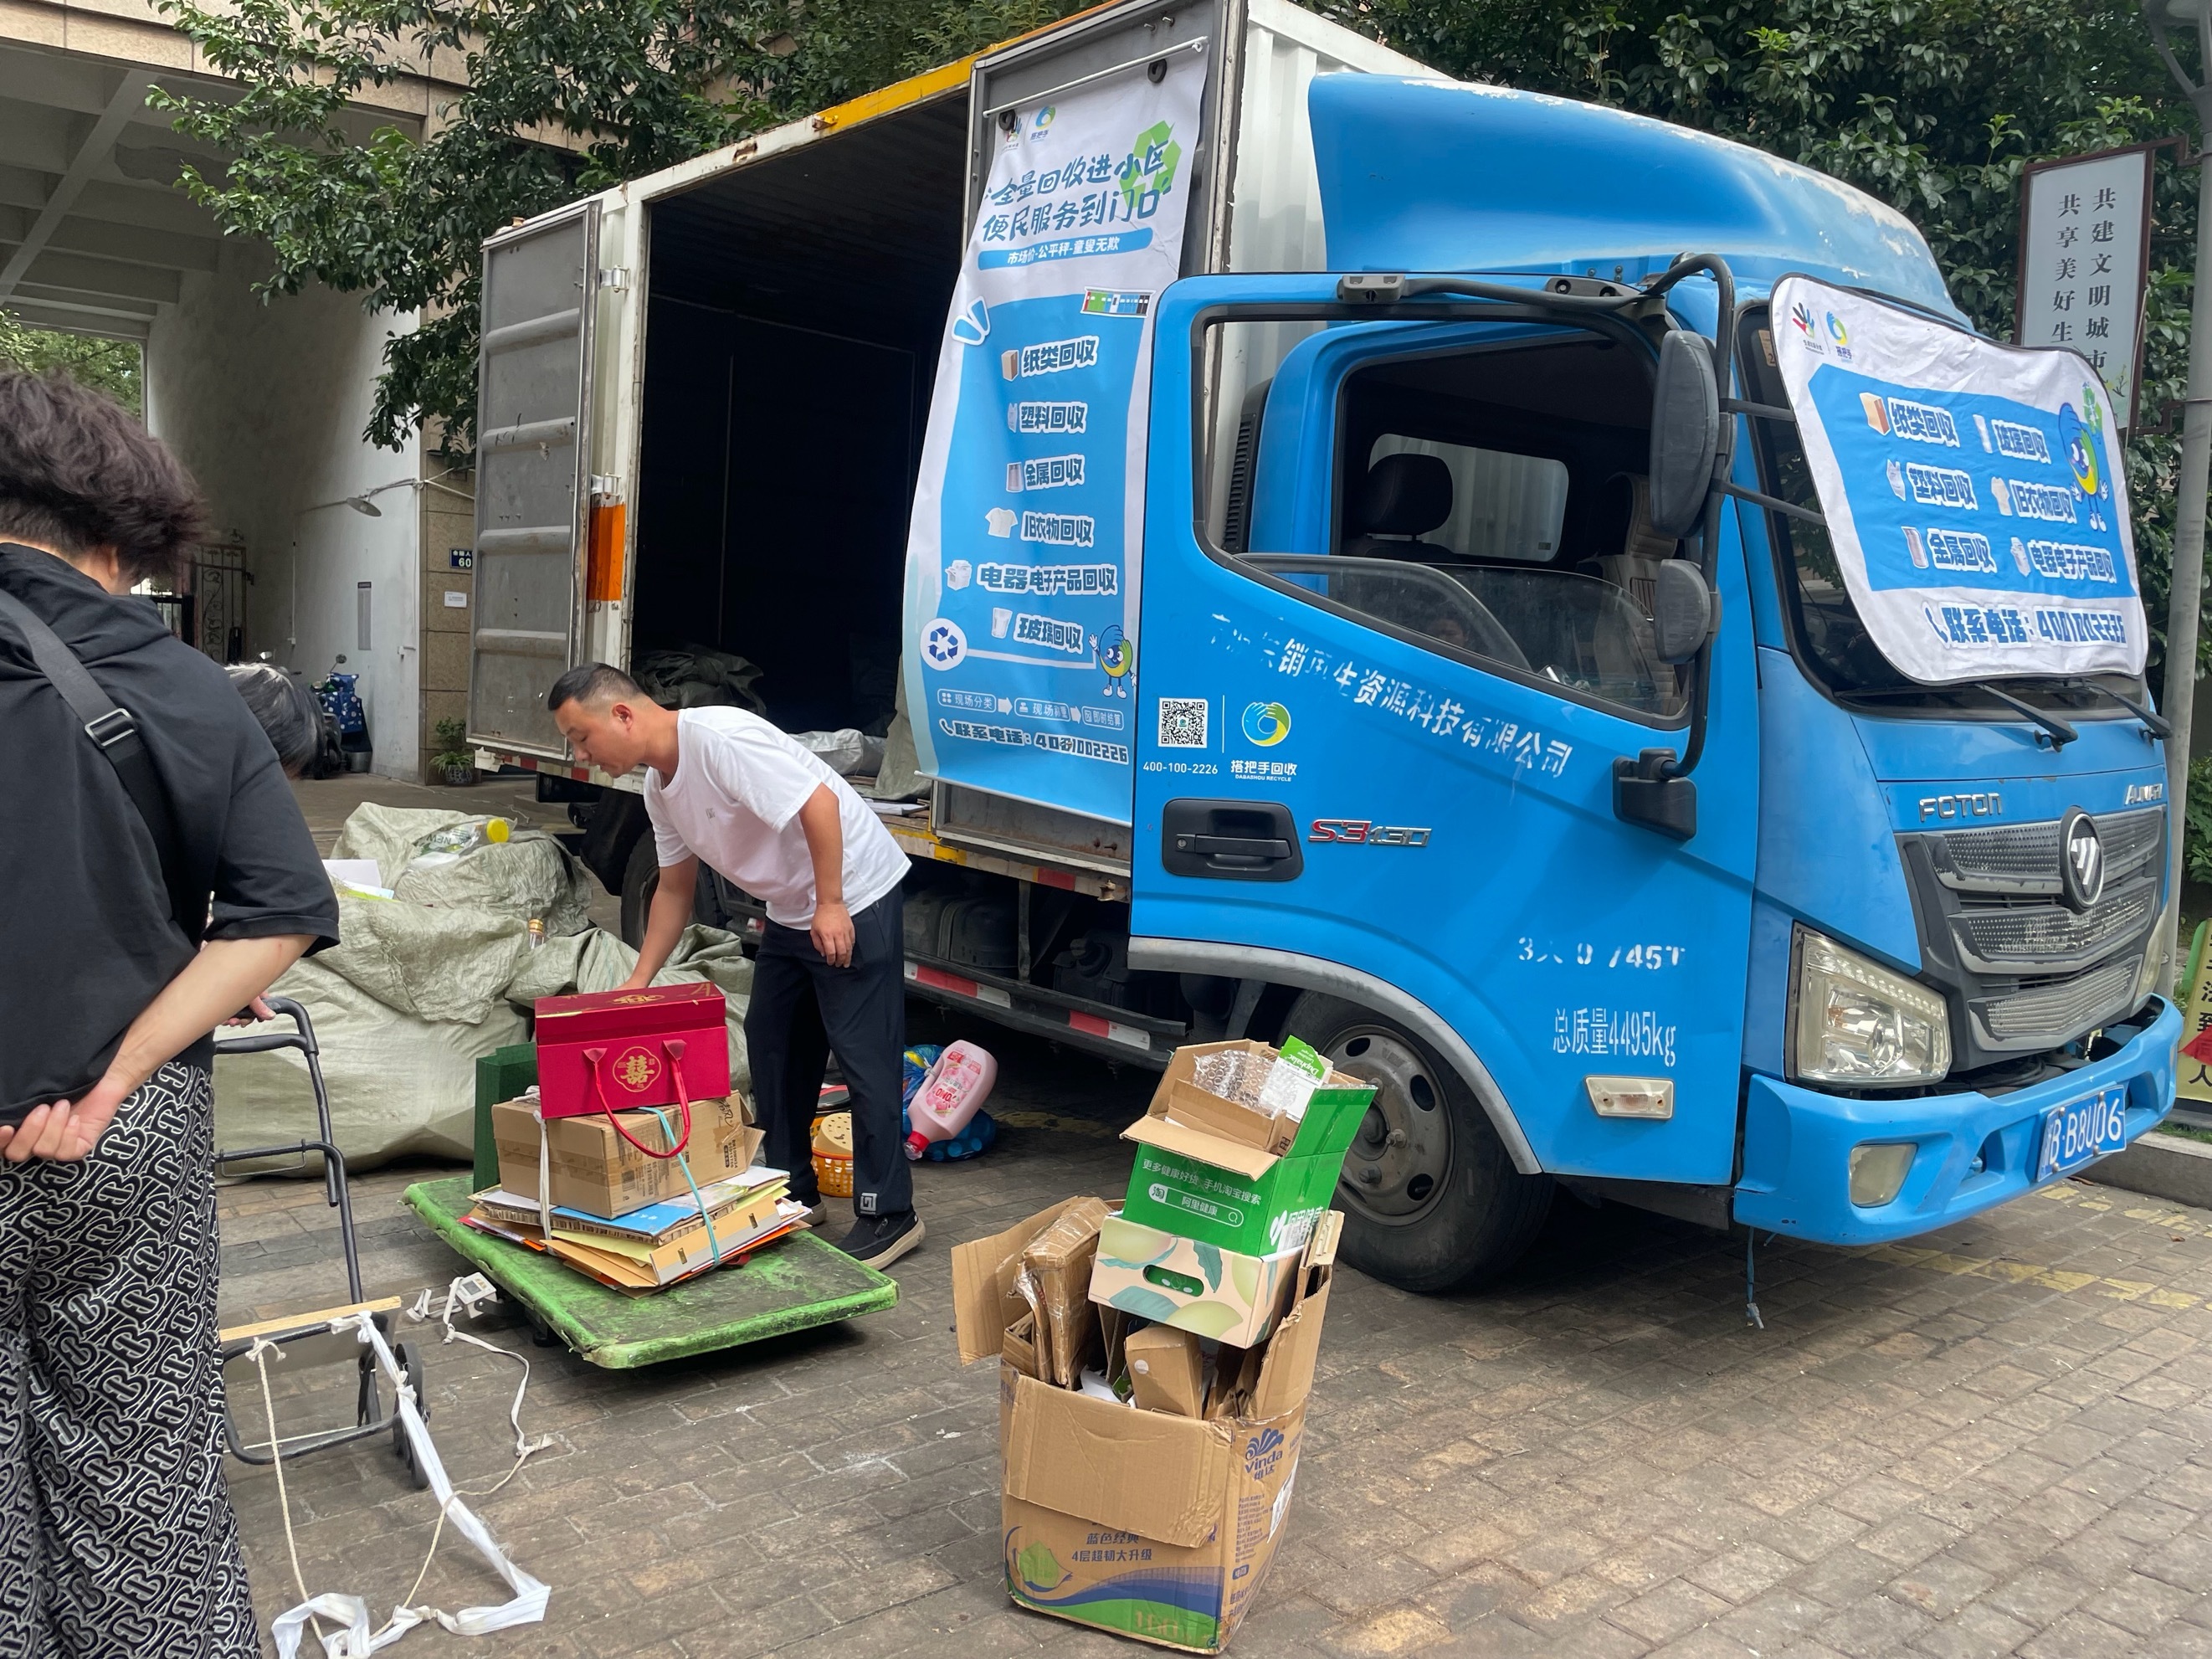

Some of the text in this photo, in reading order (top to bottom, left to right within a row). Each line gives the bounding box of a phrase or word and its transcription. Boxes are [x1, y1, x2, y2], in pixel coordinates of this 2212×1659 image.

[2050, 193, 2081, 345] 共享美好生
[2085, 187, 2116, 371] 共建文明城市
[1023, 338, 1096, 373] 纸类回收
[1021, 404, 1085, 430] 塑料回收
[1891, 402, 2050, 460] 纸类回收 玻璃回收
[1024, 457, 1083, 487] 金属回收
[1908, 468, 2076, 520] 塑料回收 旧衣物回收
[1024, 515, 1092, 544] 旧衣物回收
[1929, 532, 2116, 580] 金属回收 电器电子产品回收
[1016, 616, 1082, 650] 玻璃回收
[954, 693, 993, 711] 现场分类
[1143, 762, 1219, 775] 400-100-2226
[1230, 760, 1297, 777] 搭把手回收
[1919, 792, 2003, 822] FOTON
[1553, 1008, 1676, 1067] 总质量4495kg
[1142, 1158, 1262, 1206] 更多健康好货 手机淘宝搜索
[1152, 1185, 1219, 1216] 淘 阿里健康
[1071, 1549, 1152, 1563] 4层超韧大升级
